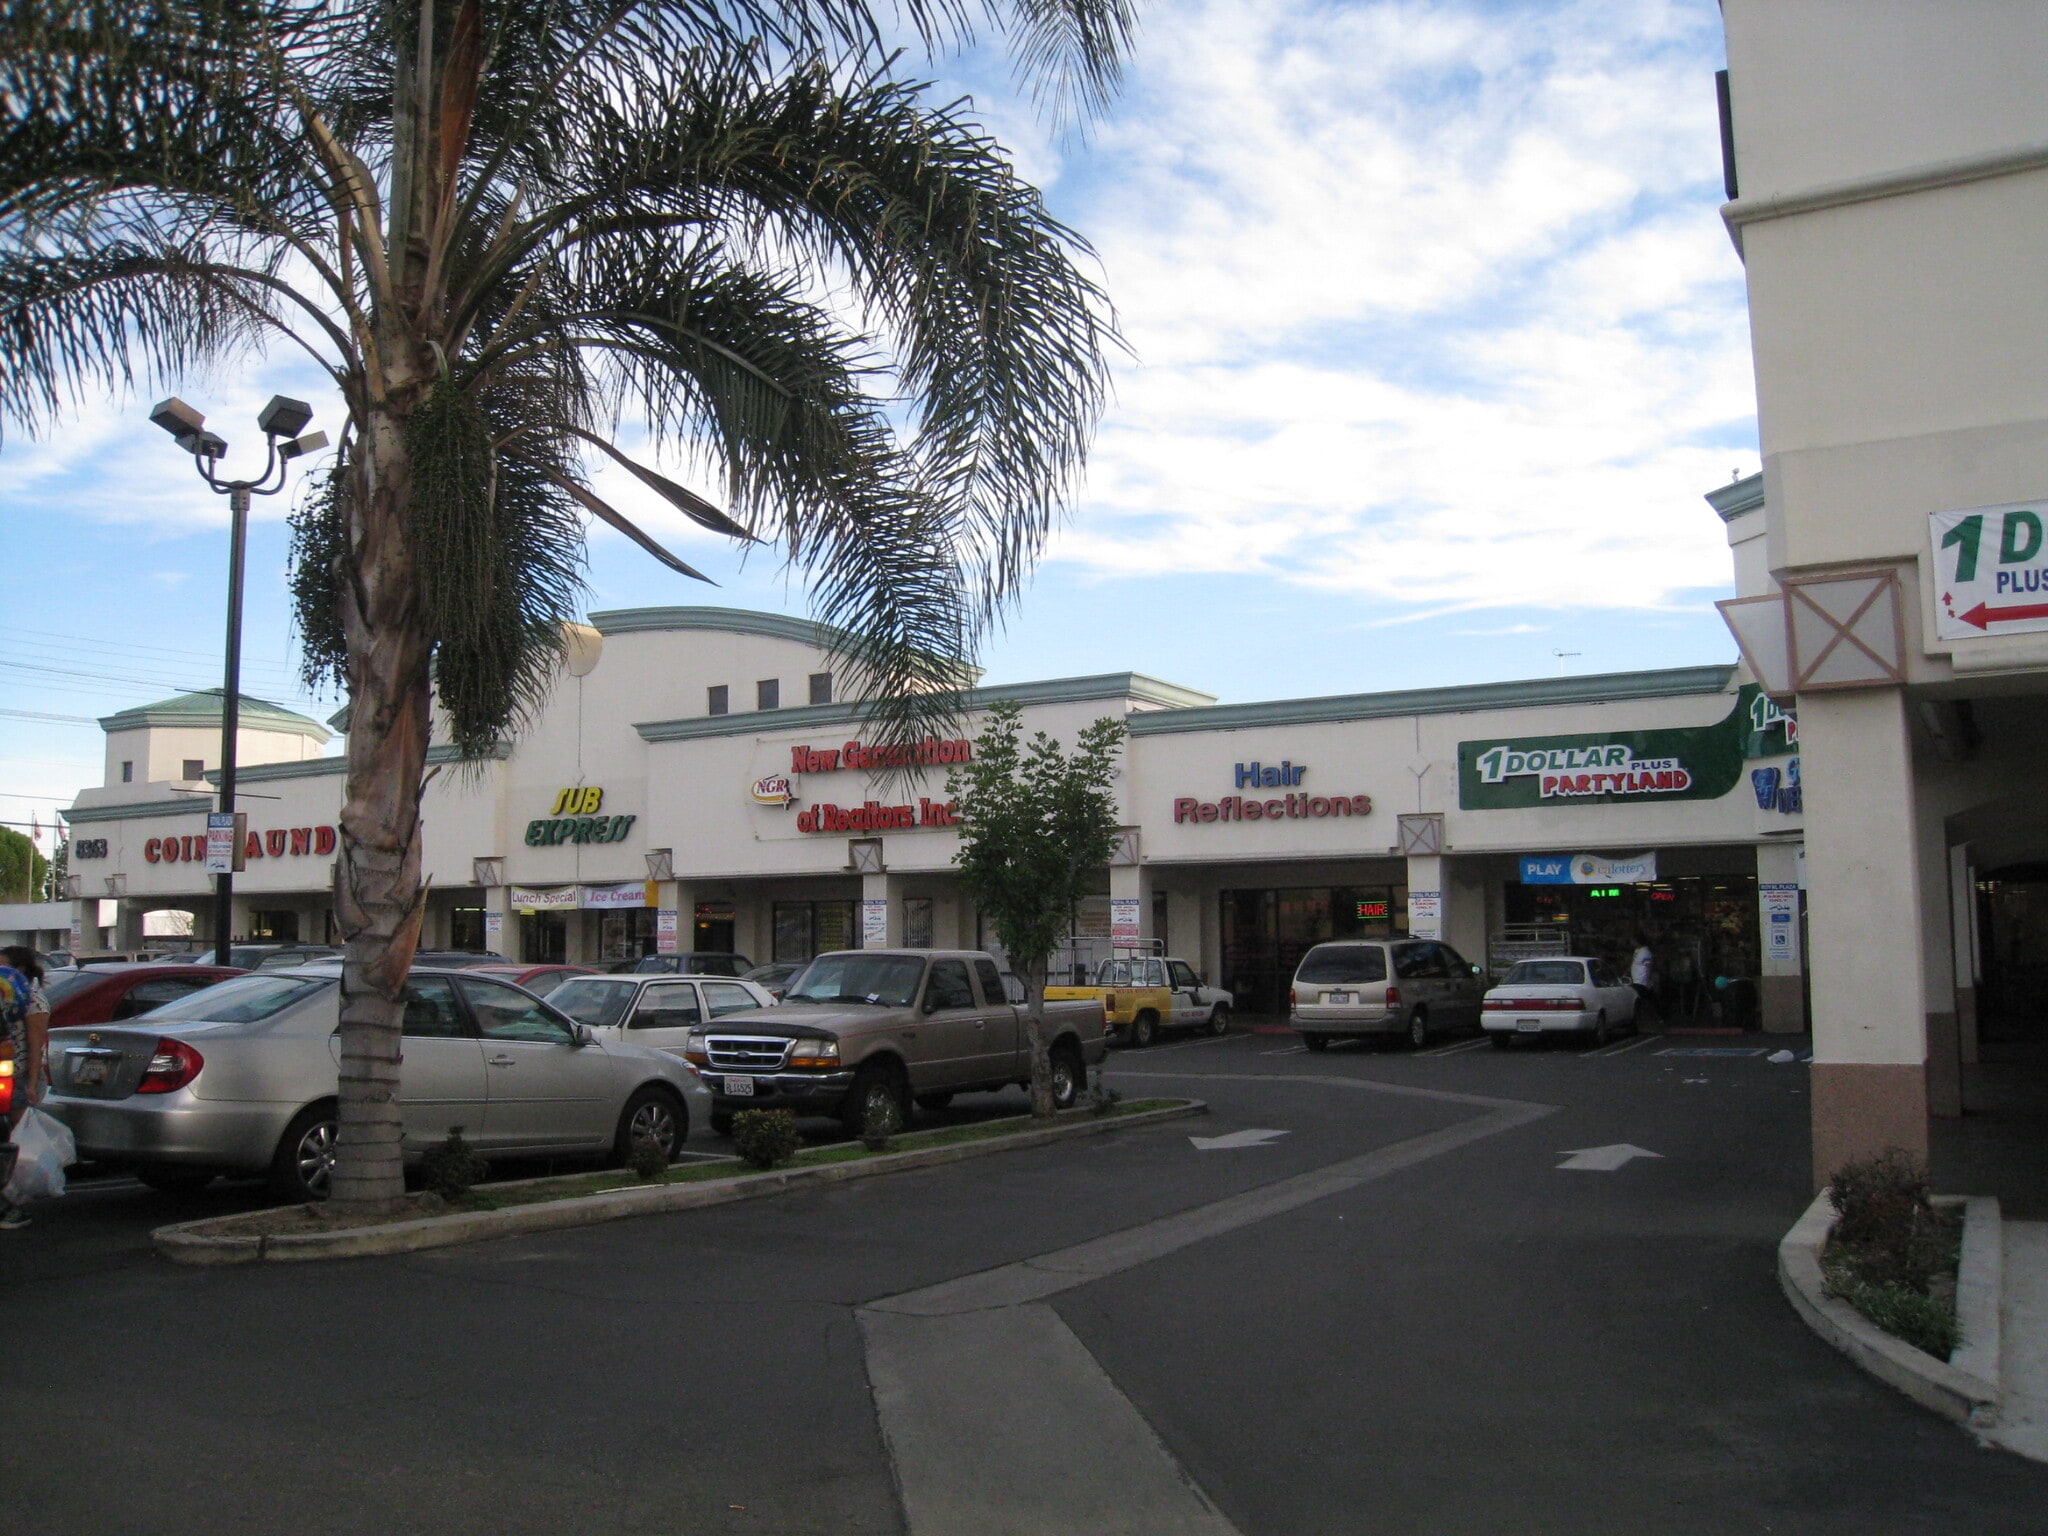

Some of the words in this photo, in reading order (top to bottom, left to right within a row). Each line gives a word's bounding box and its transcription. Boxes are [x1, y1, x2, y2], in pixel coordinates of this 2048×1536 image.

[1941, 514, 1983, 583] 1
[791, 744, 840, 774] New
[1482, 749, 1504, 780] 1
[1505, 747, 1627, 774] DOLLAR
[1630, 759, 1673, 771] PLUS
[756, 779, 787, 794] NGR
[1234, 760, 1307, 789] Hair
[1542, 769, 1689, 795] PARTYLAND
[549, 787, 604, 816] SUB
[1174, 792, 1373, 824] Reflections
[525, 815, 638, 847] EXPRESS
[797, 803, 821, 833] of
[822, 801, 915, 832] Realtors
[1527, 863, 1563, 876] PLAY
[512, 890, 542, 904] Lunch
[544, 890, 577, 904] Special
[590, 891, 608, 902] Ice
[610, 890, 646, 901] Cream
[1359, 904, 1386, 916] HAIR
